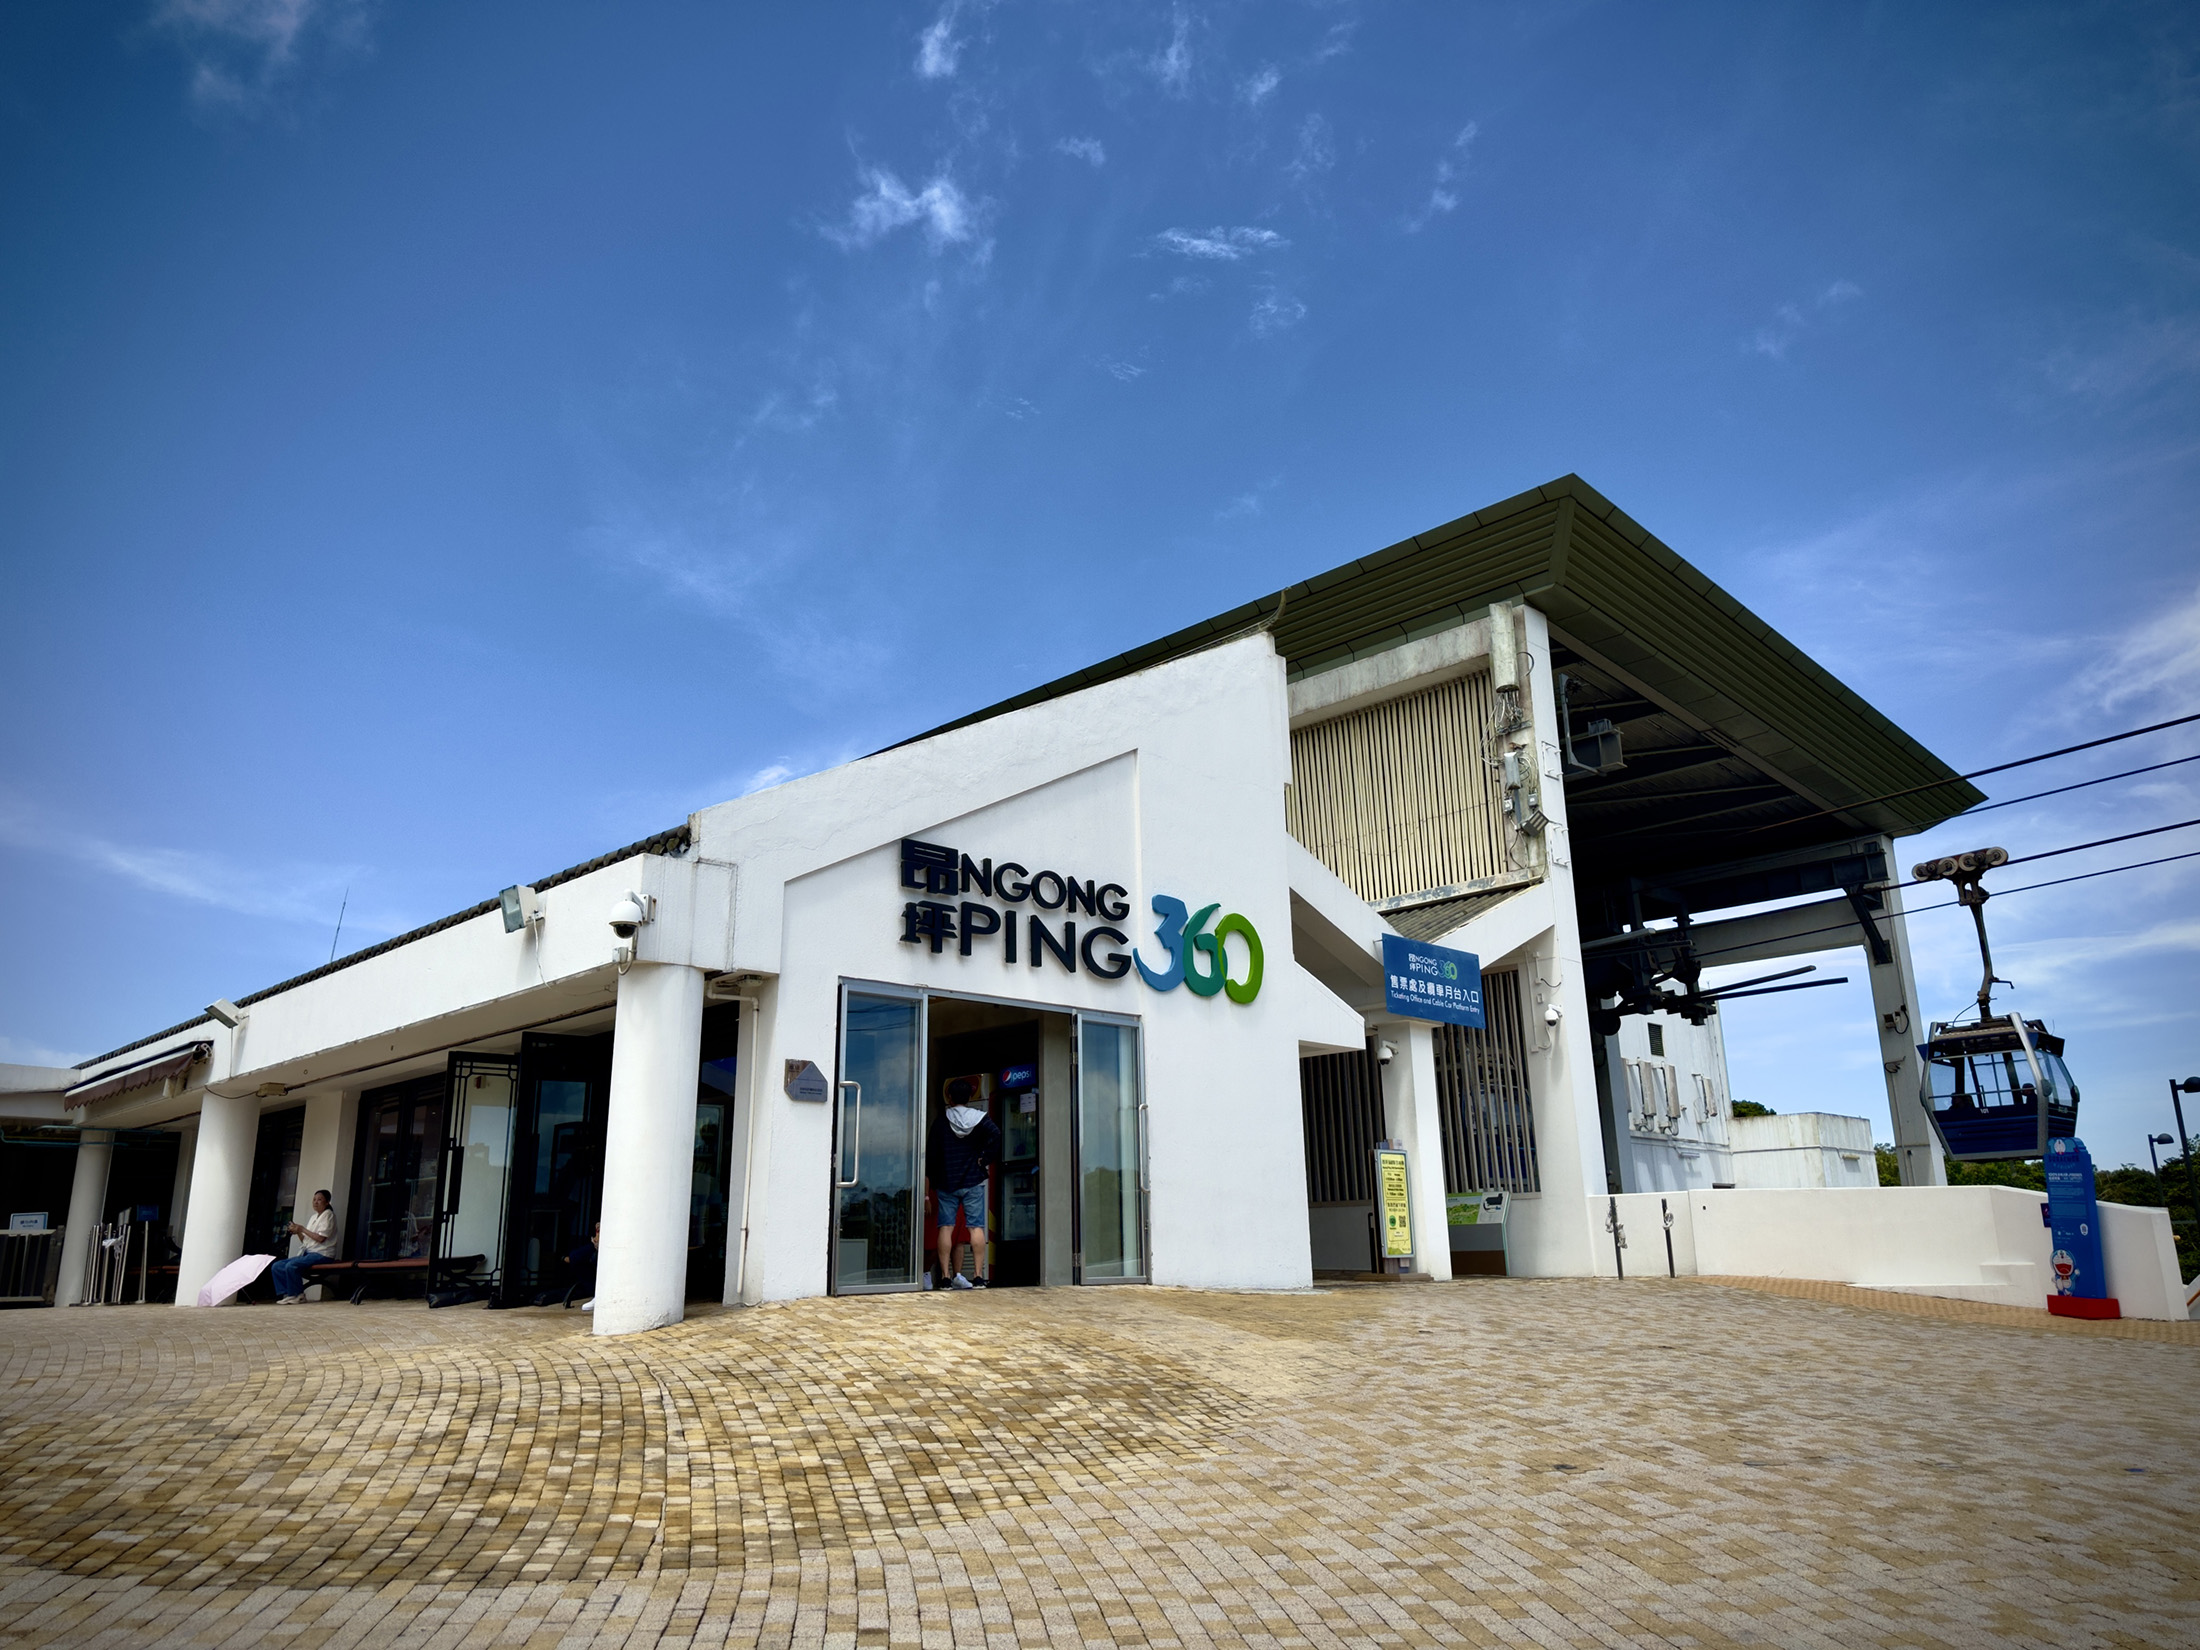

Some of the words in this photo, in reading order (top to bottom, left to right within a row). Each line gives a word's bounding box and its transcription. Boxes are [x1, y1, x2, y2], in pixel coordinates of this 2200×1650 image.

[960, 853, 1130, 921] NGONG
[960, 901, 1132, 979] PING
[1133, 894, 1264, 1005] 360
[1416, 963, 1438, 976] PING
[1438, 959, 1457, 980] 360
